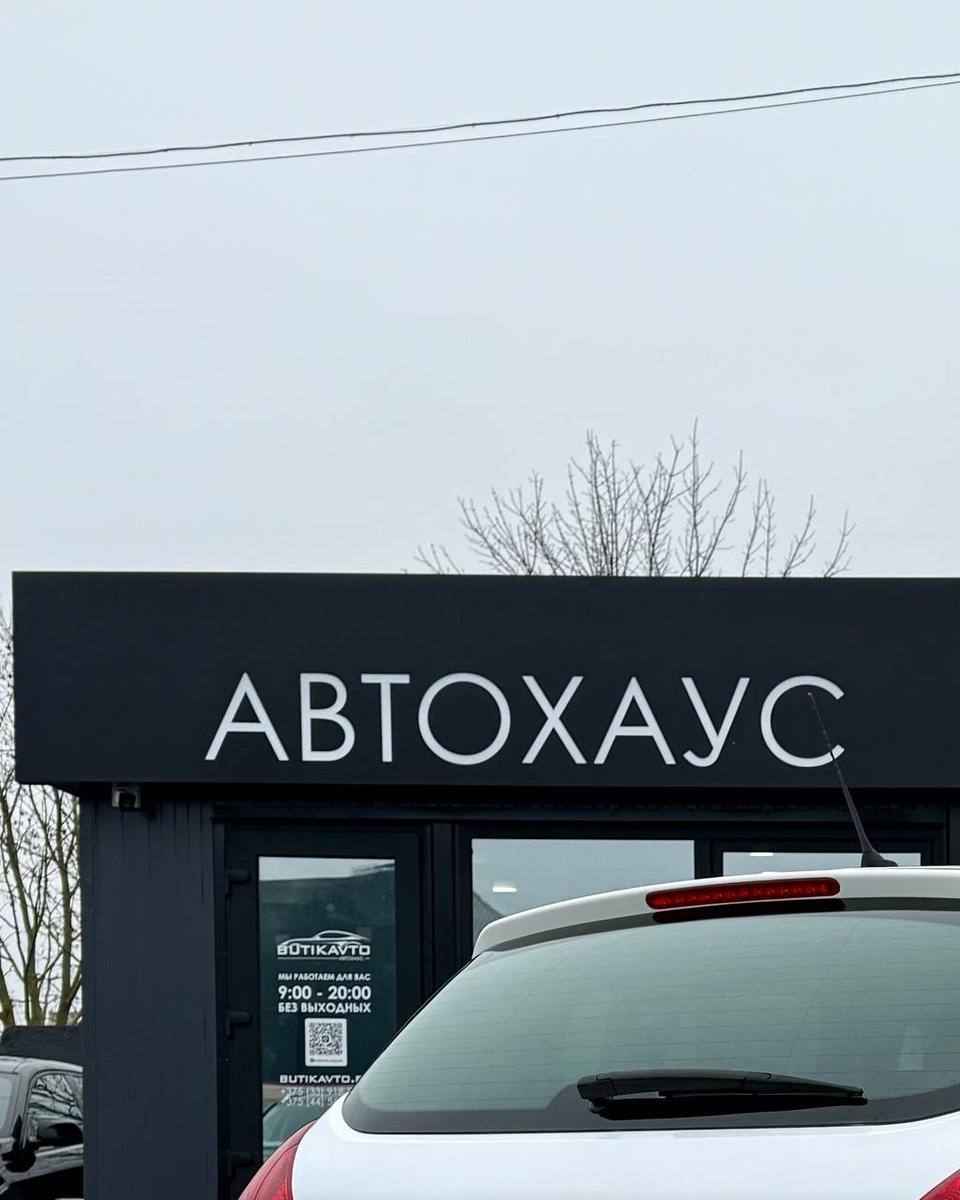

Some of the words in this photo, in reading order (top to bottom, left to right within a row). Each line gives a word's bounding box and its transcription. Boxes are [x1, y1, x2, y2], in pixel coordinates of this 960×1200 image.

[204, 671, 846, 769] АВТОХАУС
[277, 944, 371, 956] BUTIKAVTO
[294, 973, 335, 981] РАБОТАЕМ
[336, 973, 353, 982] ДЛЯ
[354, 973, 371, 981] ВАС
[278, 985, 312, 1000] 9:00
[328, 985, 372, 1000] 20:00
[278, 1002, 298, 1013] БЕЗ
[300, 1002, 372, 1014] ВЫХОДНЫХ
